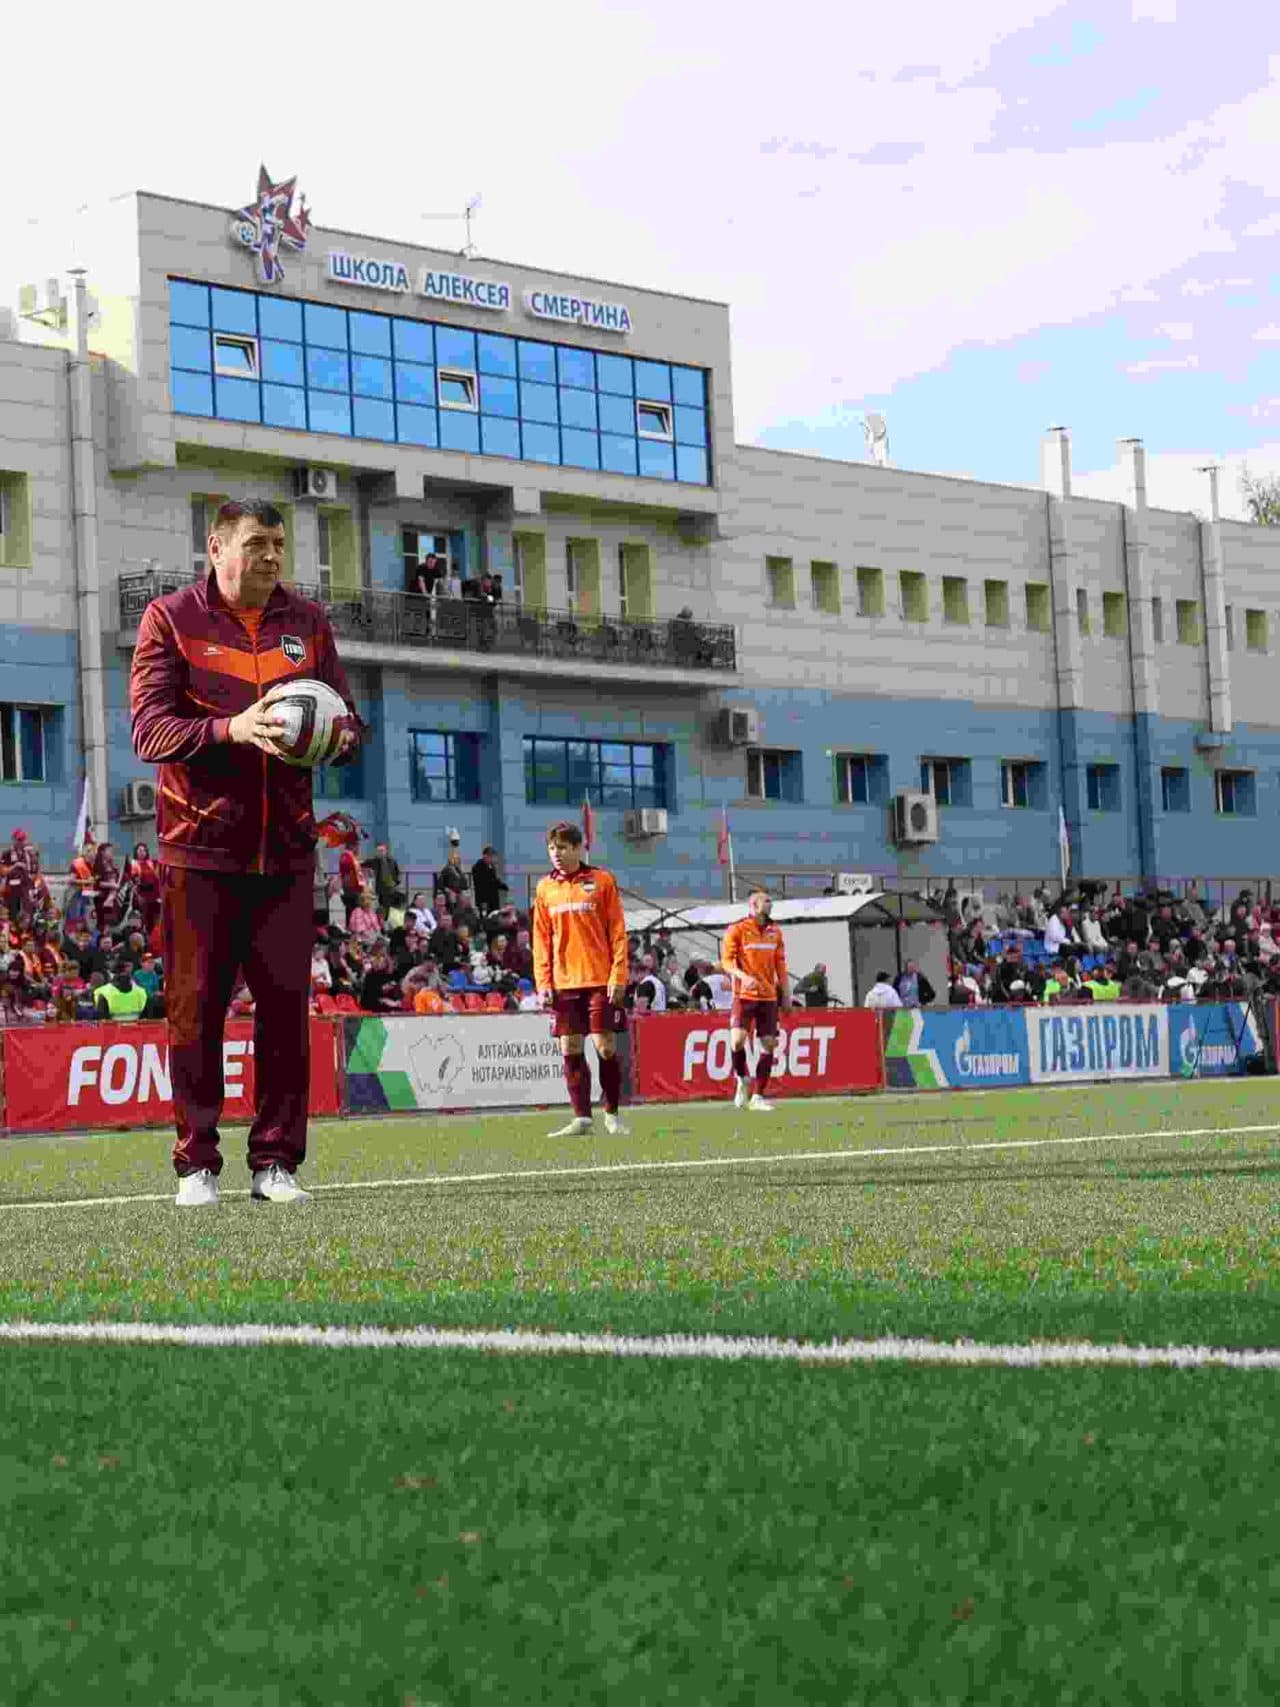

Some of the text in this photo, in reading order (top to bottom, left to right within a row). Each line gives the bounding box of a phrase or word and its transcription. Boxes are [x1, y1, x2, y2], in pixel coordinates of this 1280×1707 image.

[330, 255, 631, 331] ШКОЛА АЛЕКСЕЯ СМЕРТИНА
[67, 1041, 255, 1106] FONE
[477, 1041, 538, 1059] АЛТАЙСКАЯ
[1039, 1013, 1160, 1074] ГАЗПРОМ
